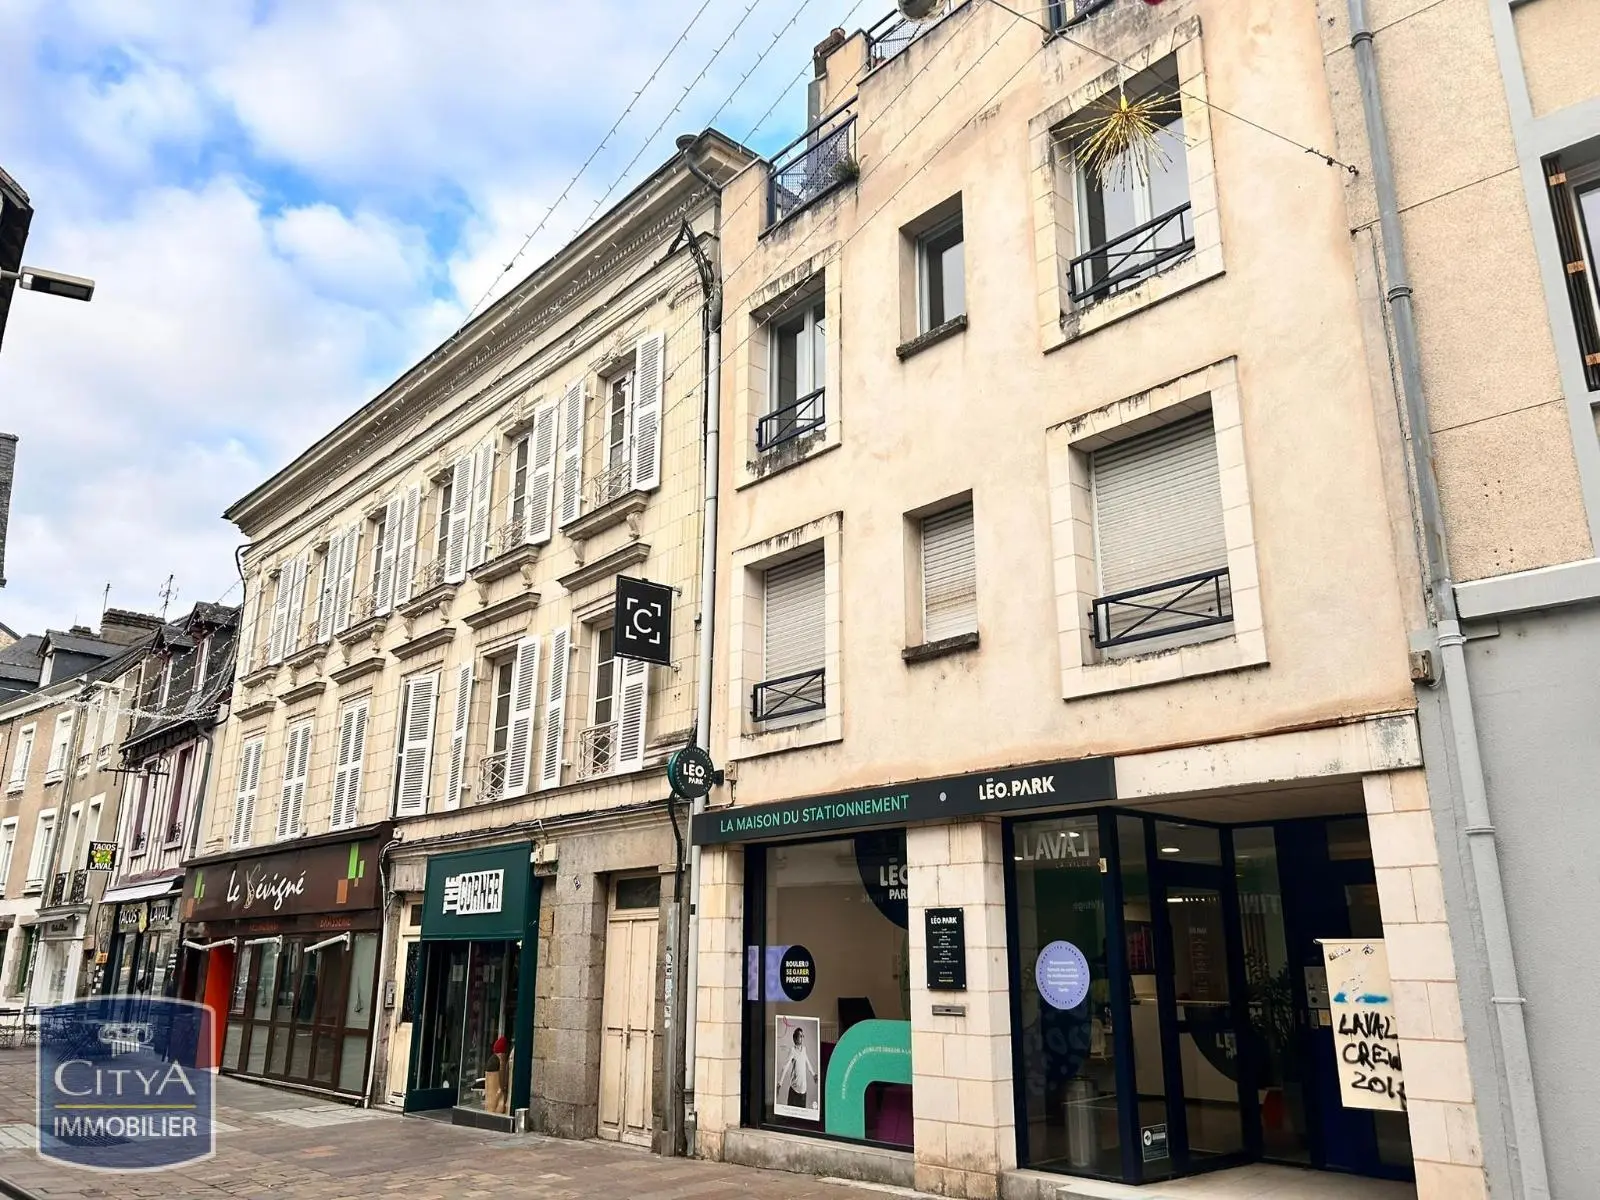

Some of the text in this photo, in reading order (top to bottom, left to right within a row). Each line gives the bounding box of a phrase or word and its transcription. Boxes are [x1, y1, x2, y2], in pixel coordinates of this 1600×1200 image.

[633, 608, 652, 634] C
[688, 776, 705, 785] PARK
[720, 794, 910, 833] LA MAISON DU STATIONNEMENT
[93, 843, 116, 851] TACOS
[90, 862, 112, 870] LAVAL
[227, 869, 240, 903] Le
[889, 888, 909, 900] PAR
[120, 906, 169, 924] TACOS LAVAL
[785, 976, 810, 984] PROFITER
[1338, 1012, 1399, 1040] LAVAL
